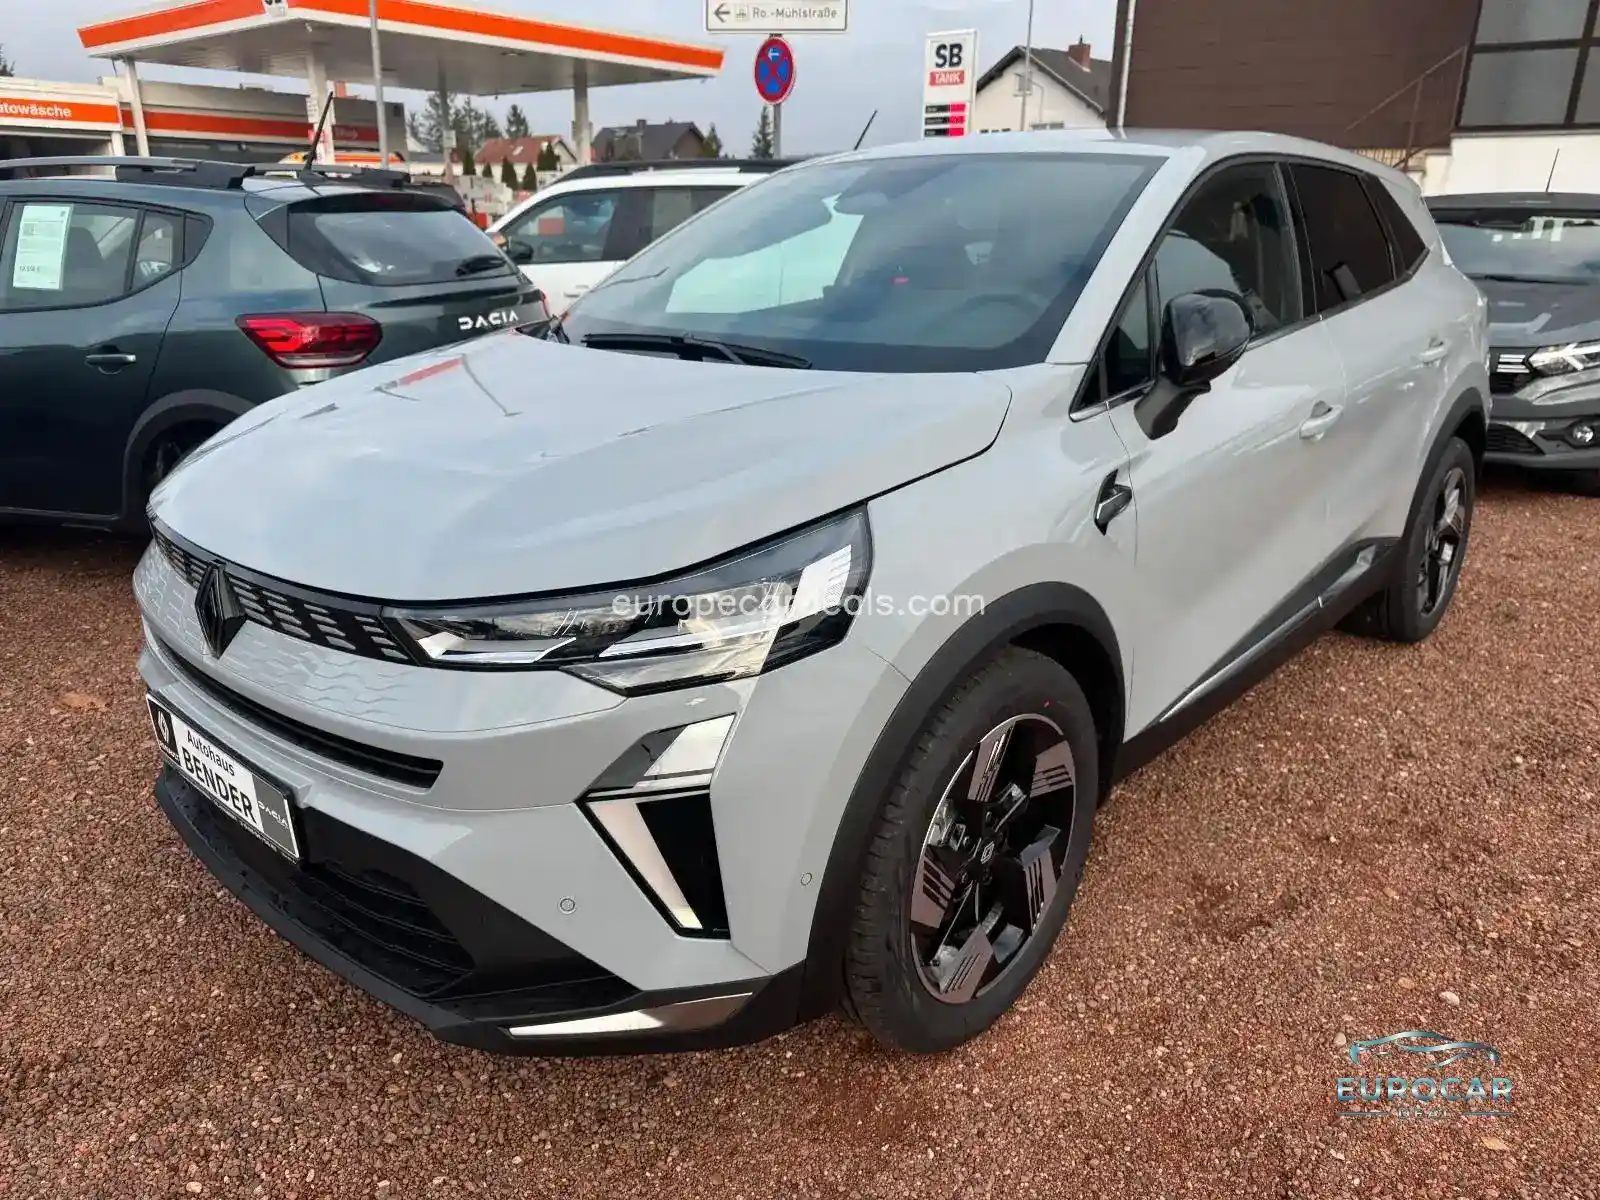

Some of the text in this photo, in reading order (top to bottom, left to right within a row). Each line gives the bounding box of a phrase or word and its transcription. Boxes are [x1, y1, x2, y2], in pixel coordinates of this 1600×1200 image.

[752, 7, 838, 18] Ro.-Mühlstraße
[935, 43, 963, 68] SB
[935, 72, 961, 84] TANK
[458, 310, 519, 330] DACIA
[187, 730, 235, 777] Autohaus
[182, 747, 257, 824] BENDER
[258, 800, 289, 830] DACIA
